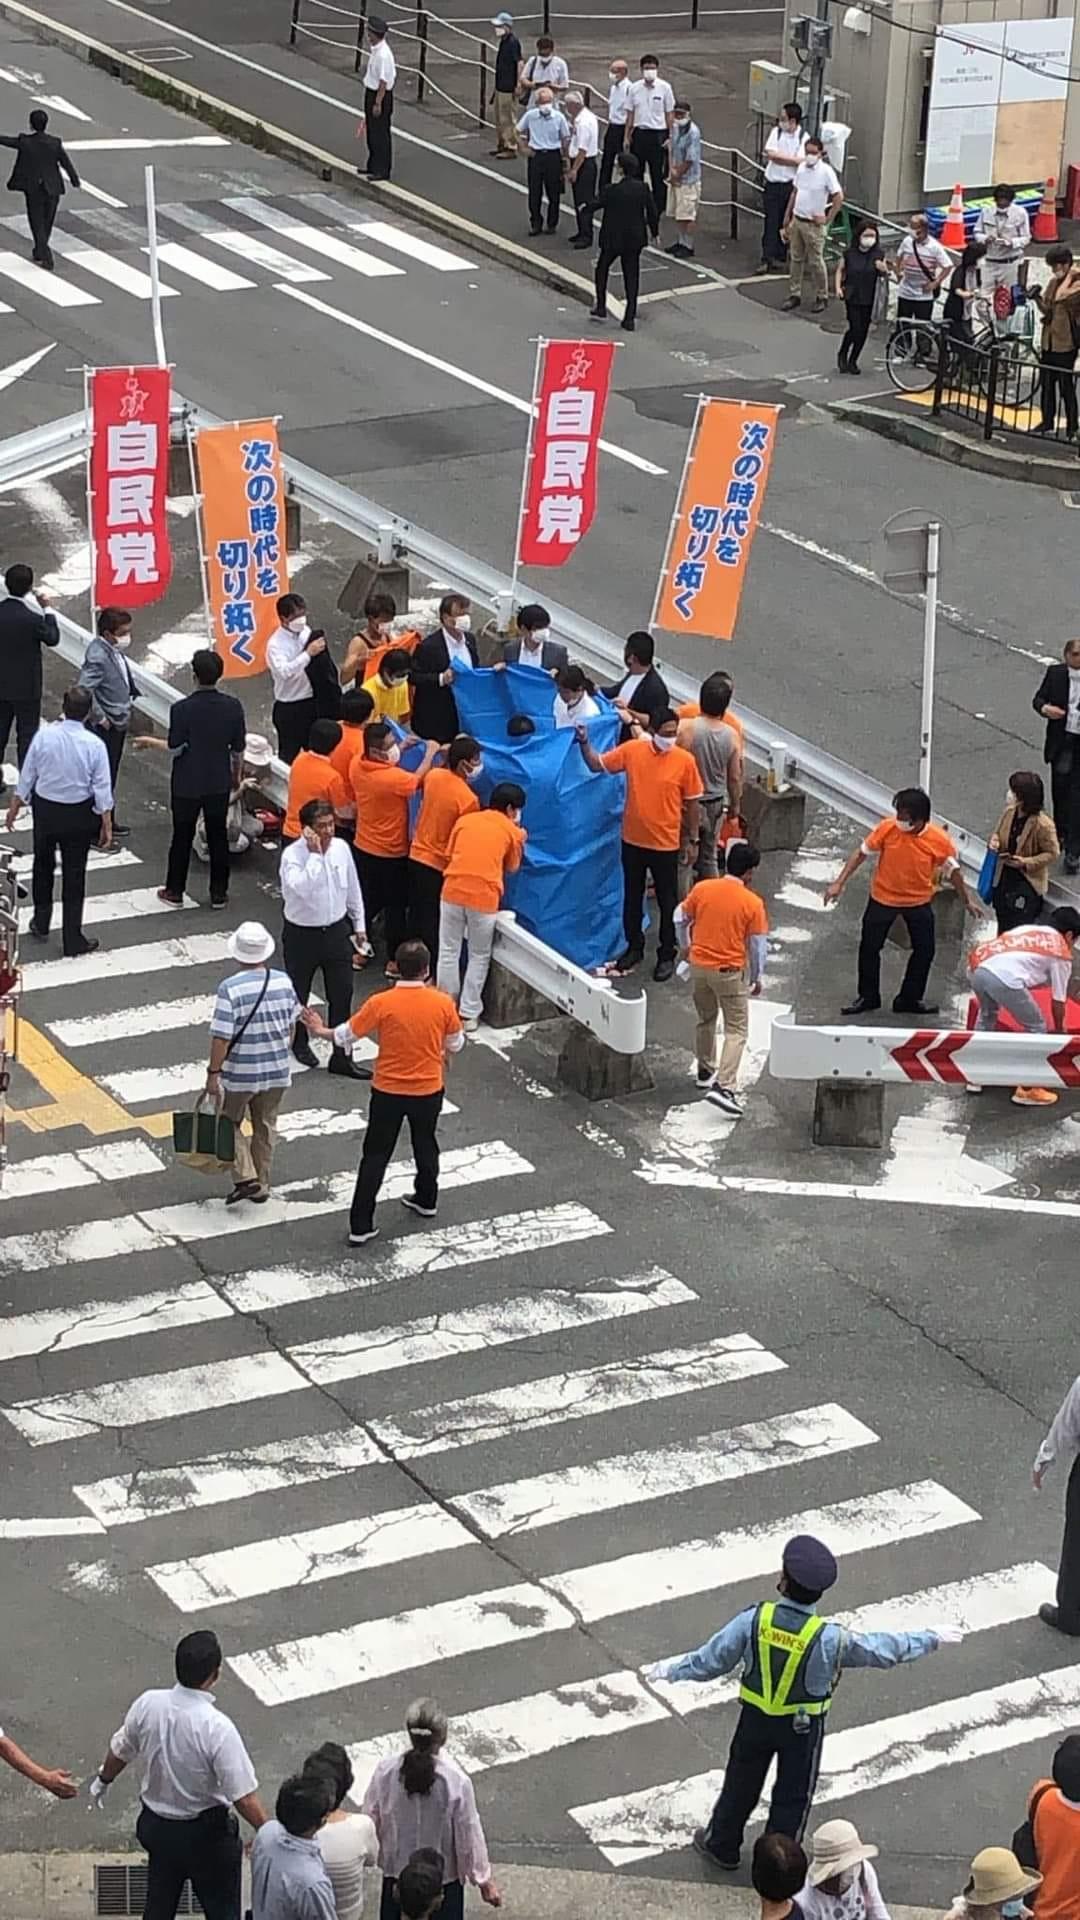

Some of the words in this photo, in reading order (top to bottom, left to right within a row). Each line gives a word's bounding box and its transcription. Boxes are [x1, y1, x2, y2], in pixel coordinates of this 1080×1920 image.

[106, 420, 159, 585] 自民党
[240, 440, 279, 595] 次の時代を
[536, 387, 596, 544] 自民党
[713, 421, 770, 565] 次の時代を
[216, 540, 256, 664] 切り拓く
[673, 505, 719, 621] 切り拓く
